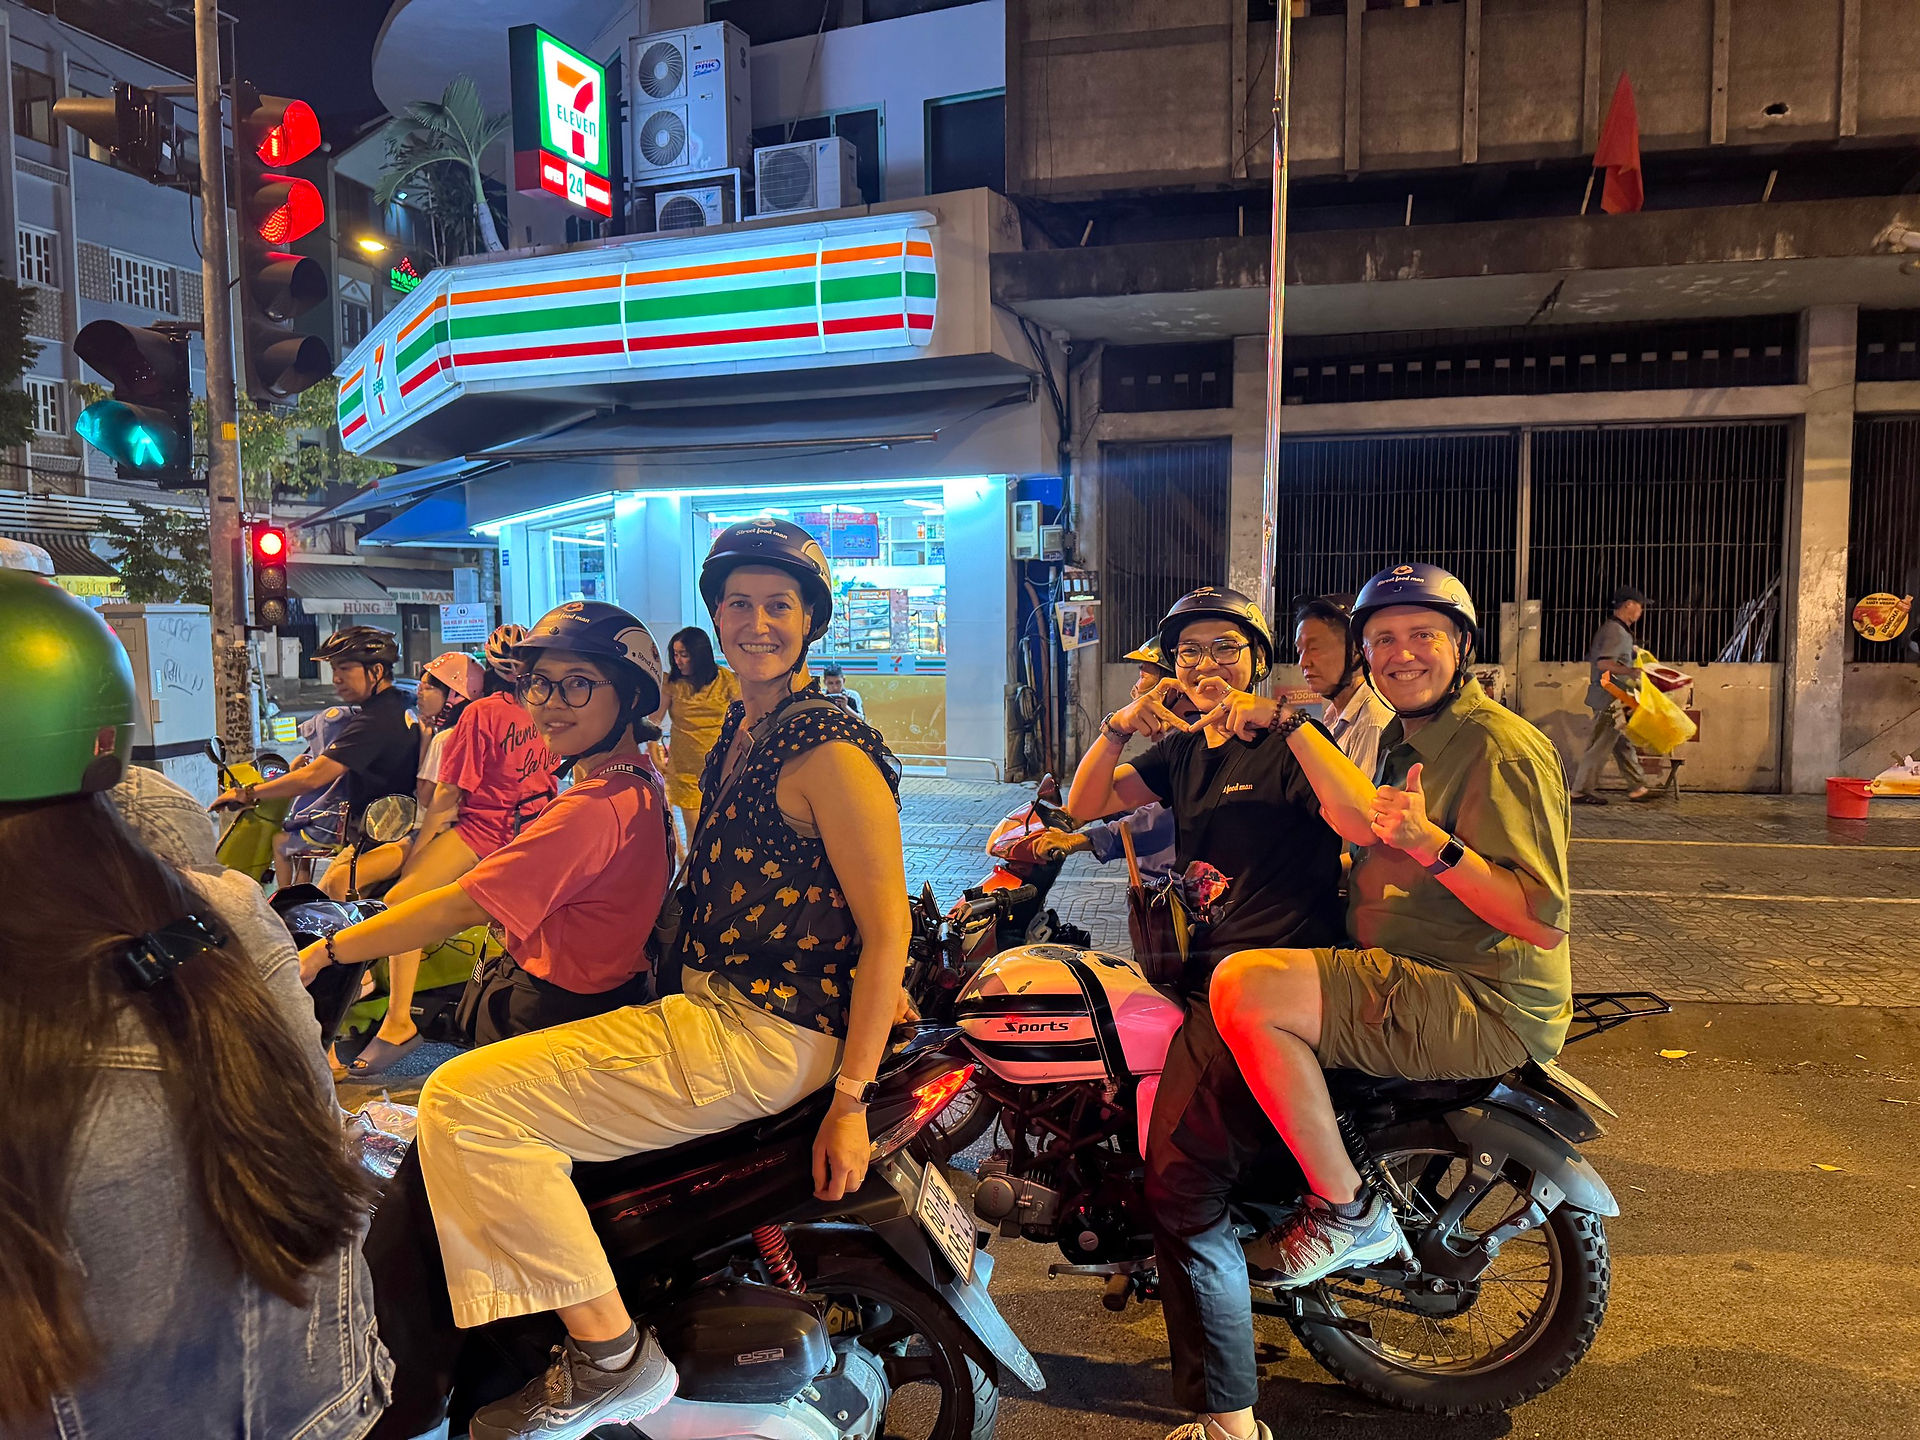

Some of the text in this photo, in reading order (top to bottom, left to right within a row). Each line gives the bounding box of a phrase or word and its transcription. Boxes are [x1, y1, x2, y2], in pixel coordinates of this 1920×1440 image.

[557, 60, 594, 158] 7
[568, 172, 584, 198] 24
[756, 527, 773, 535] food
[772, 531, 788, 540] man
[343, 600, 381, 614] HÙNG
[575, 615, 591, 623] man
[500, 721, 539, 754] Acme
[996, 1020, 1070, 1034] Sports
[945, 1202, 974, 1274] 186.43
